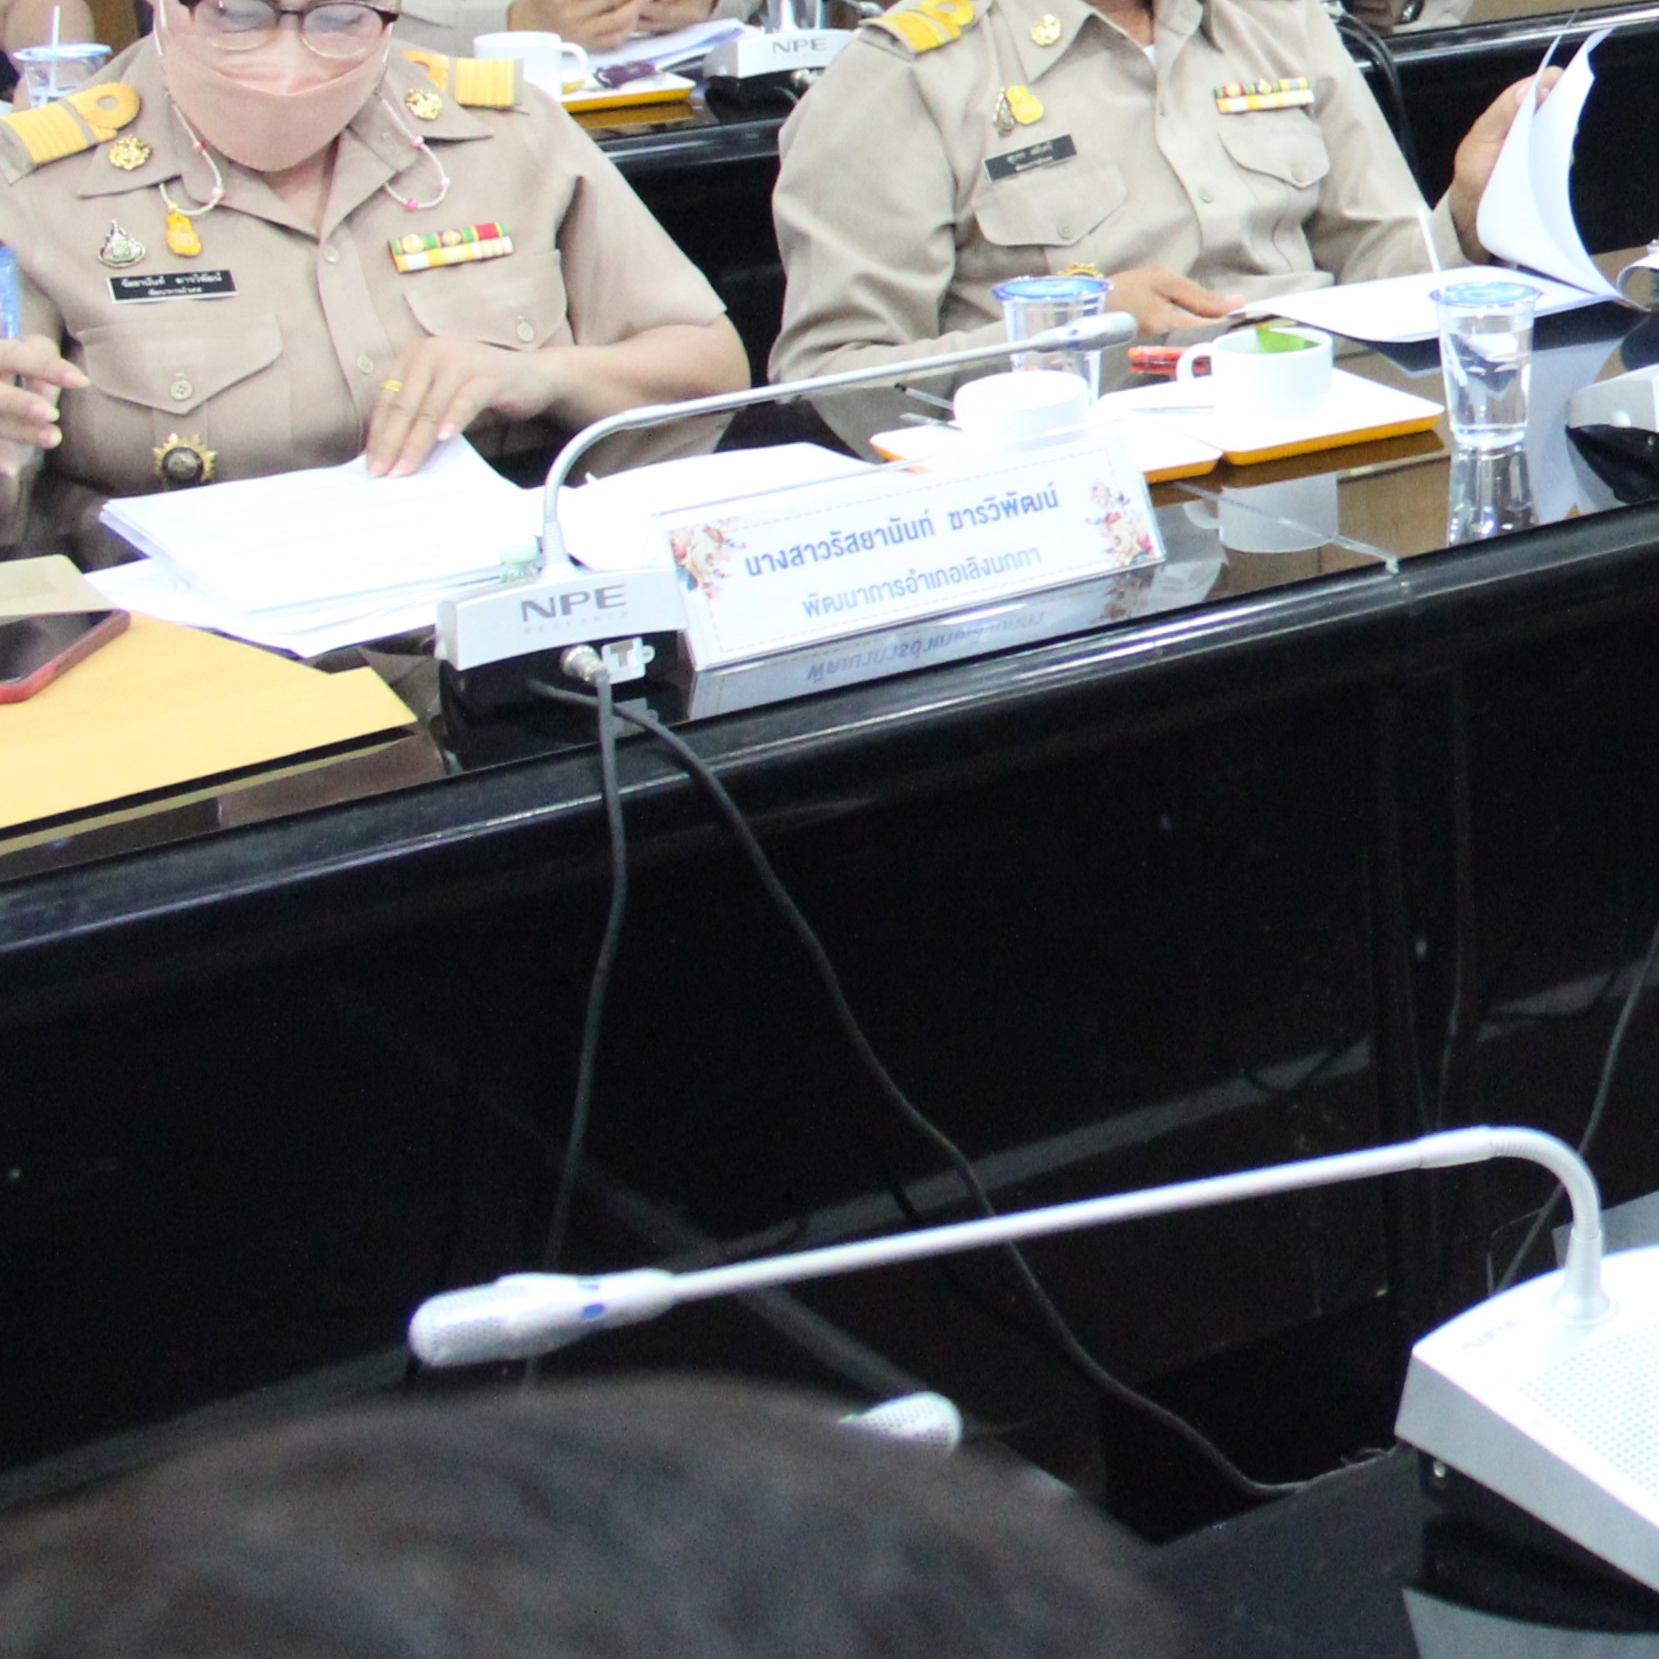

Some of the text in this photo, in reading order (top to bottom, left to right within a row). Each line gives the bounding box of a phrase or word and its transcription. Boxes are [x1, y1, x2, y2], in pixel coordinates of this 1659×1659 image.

[772, 38, 827, 54] NPE
[744, 509, 935, 577] นางสาวรัสยานันท์
[521, 584, 628, 622] NPE
[803, 546, 1042, 619] พัฒนาการอำเภอเลิงนกทา
